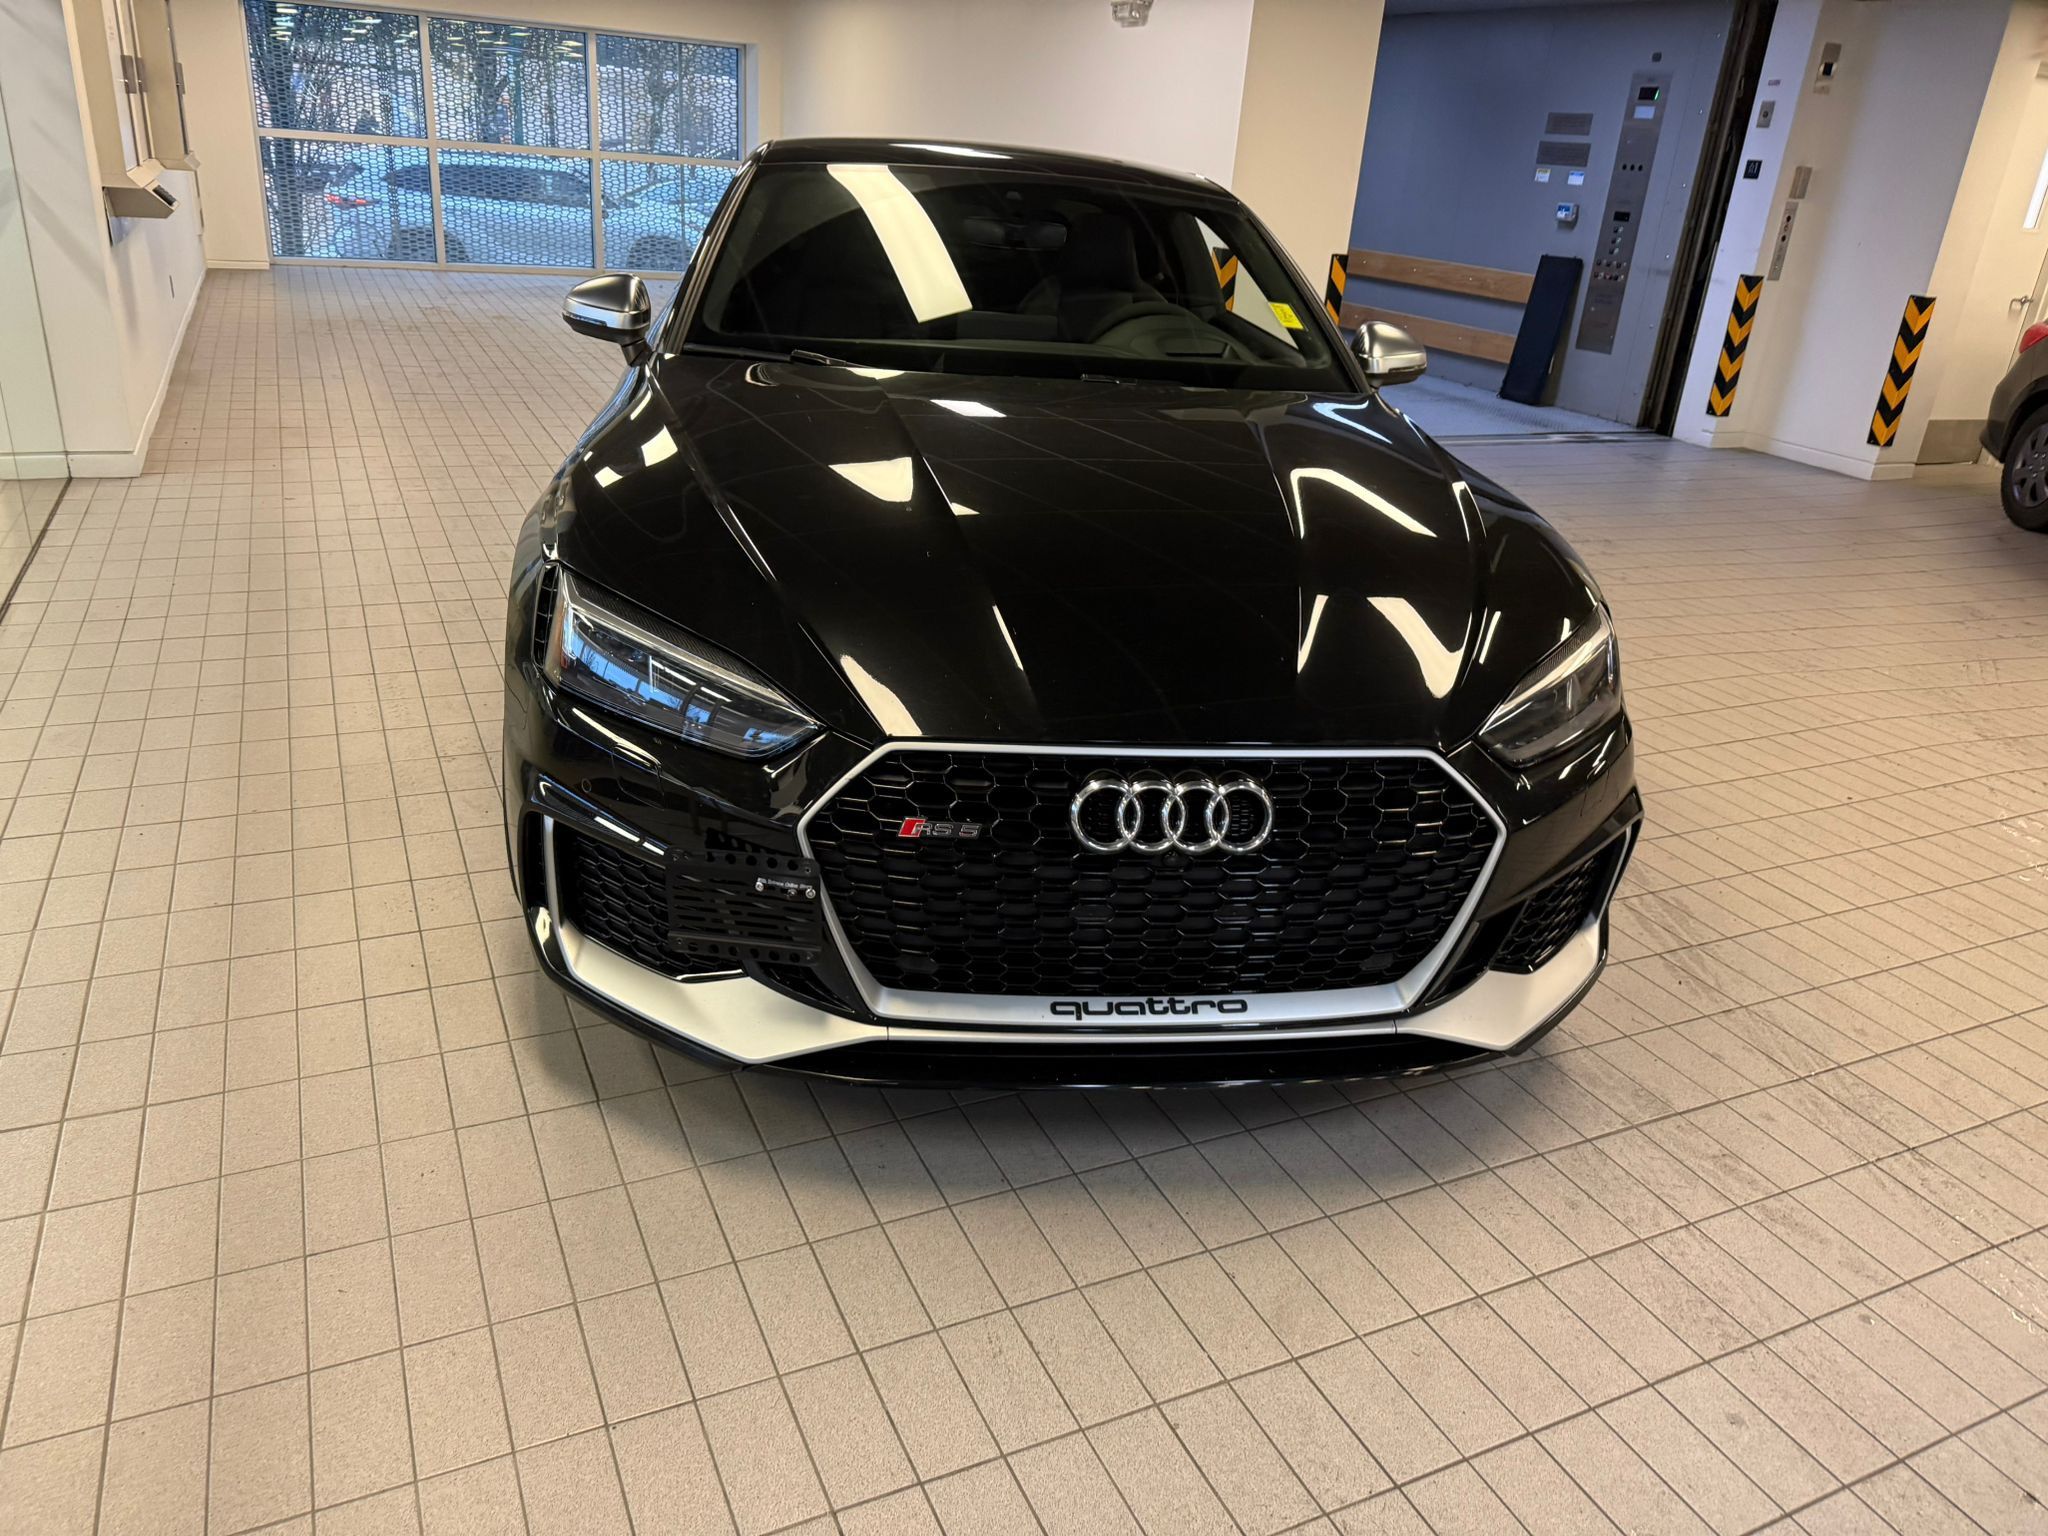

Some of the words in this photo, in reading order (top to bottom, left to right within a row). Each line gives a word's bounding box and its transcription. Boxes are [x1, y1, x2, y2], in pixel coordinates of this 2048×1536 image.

[911, 822, 954, 836] RS
[959, 823, 980, 838] 5
[1050, 997, 1249, 1021] quattro
